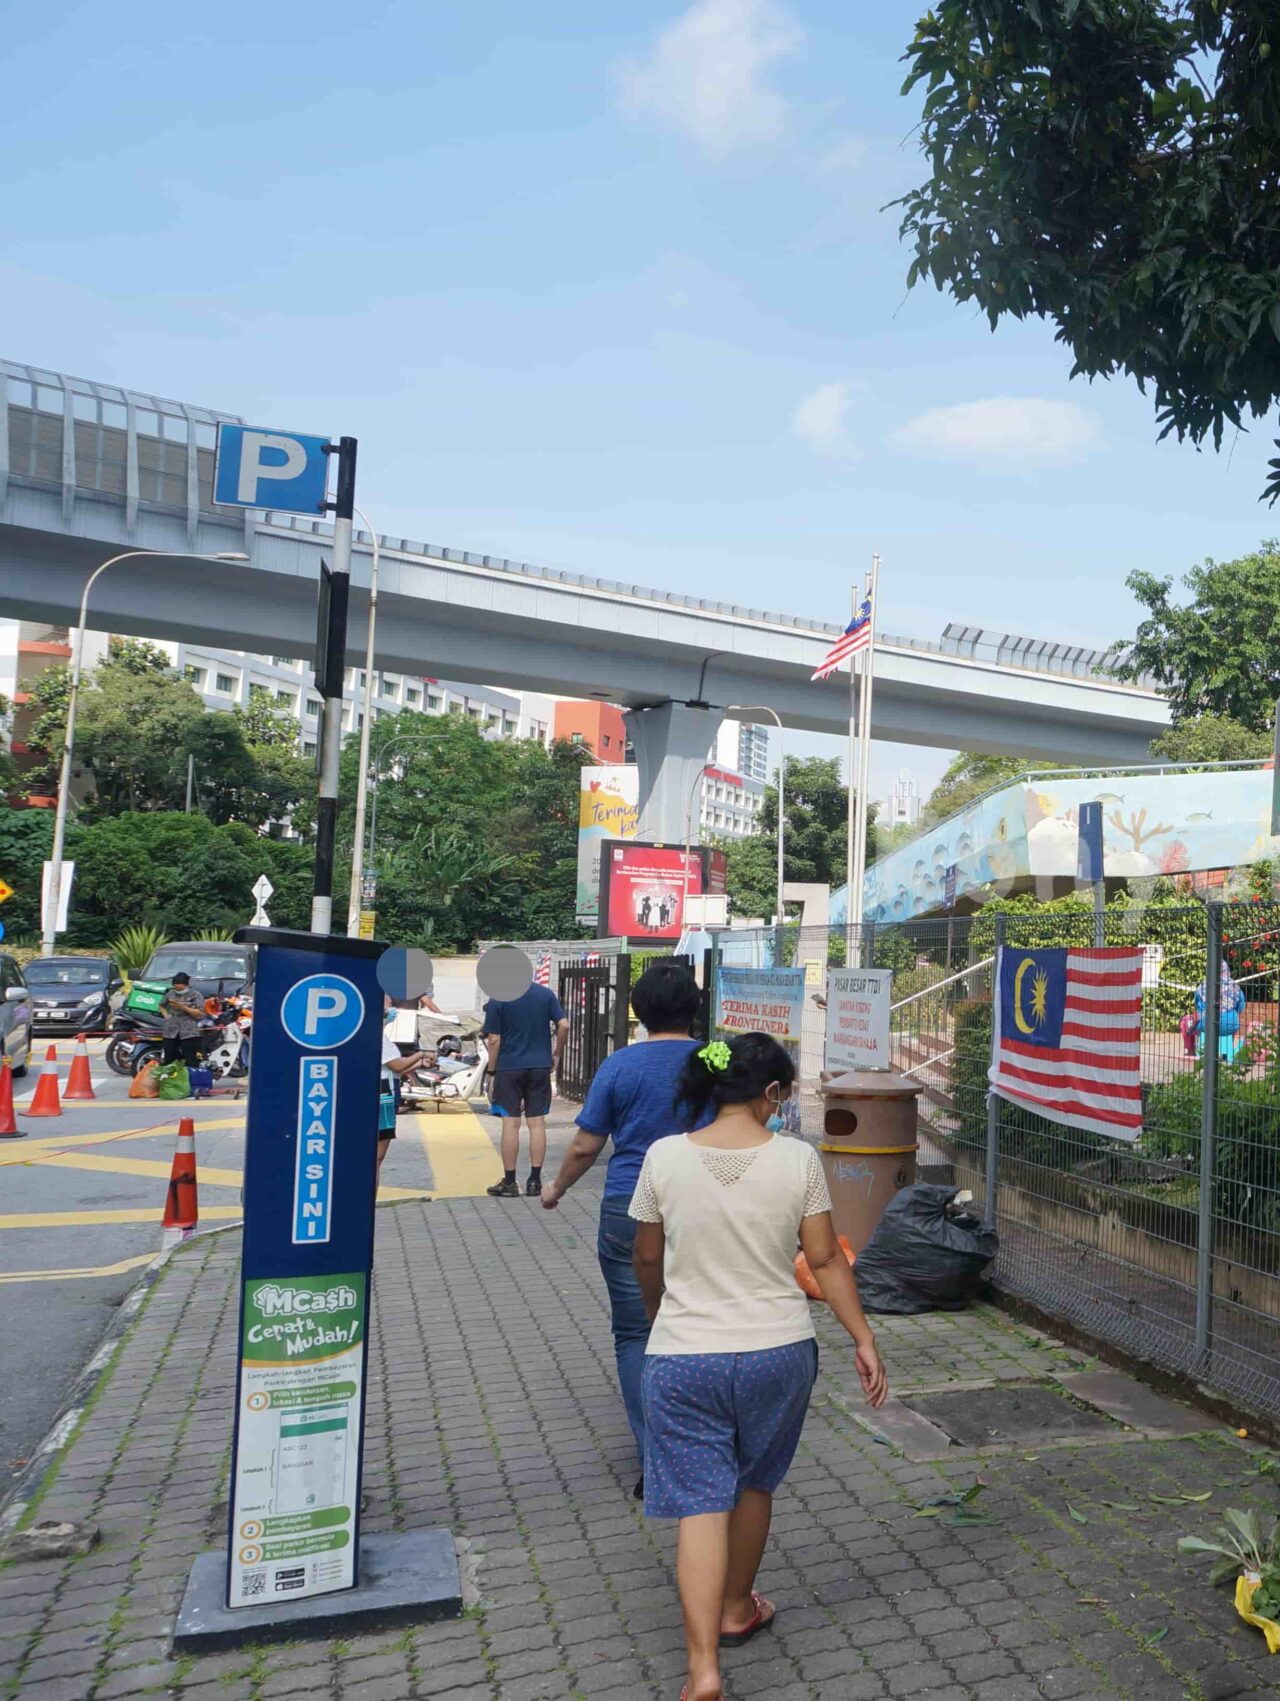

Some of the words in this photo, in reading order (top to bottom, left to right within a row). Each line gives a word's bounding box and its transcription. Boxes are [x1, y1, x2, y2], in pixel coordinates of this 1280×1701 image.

[237, 432, 308, 503] P
[834, 977, 849, 992] PASAR
[849, 978, 866, 993] BESAR
[304, 987, 347, 1035] P
[721, 999, 759, 1016] TERIMA
[761, 1004, 792, 1019] KASIH
[306, 1063, 329, 1155] BAYAR
[302, 1163, 324, 1238] SINI
[247, 1317, 305, 1343] Cepat
[305, 1318, 316, 1331] &
[286, 1320, 360, 1356] Mudah!
[247, 1526, 254, 1534] 2
[246, 1551, 253, 1559] 3
